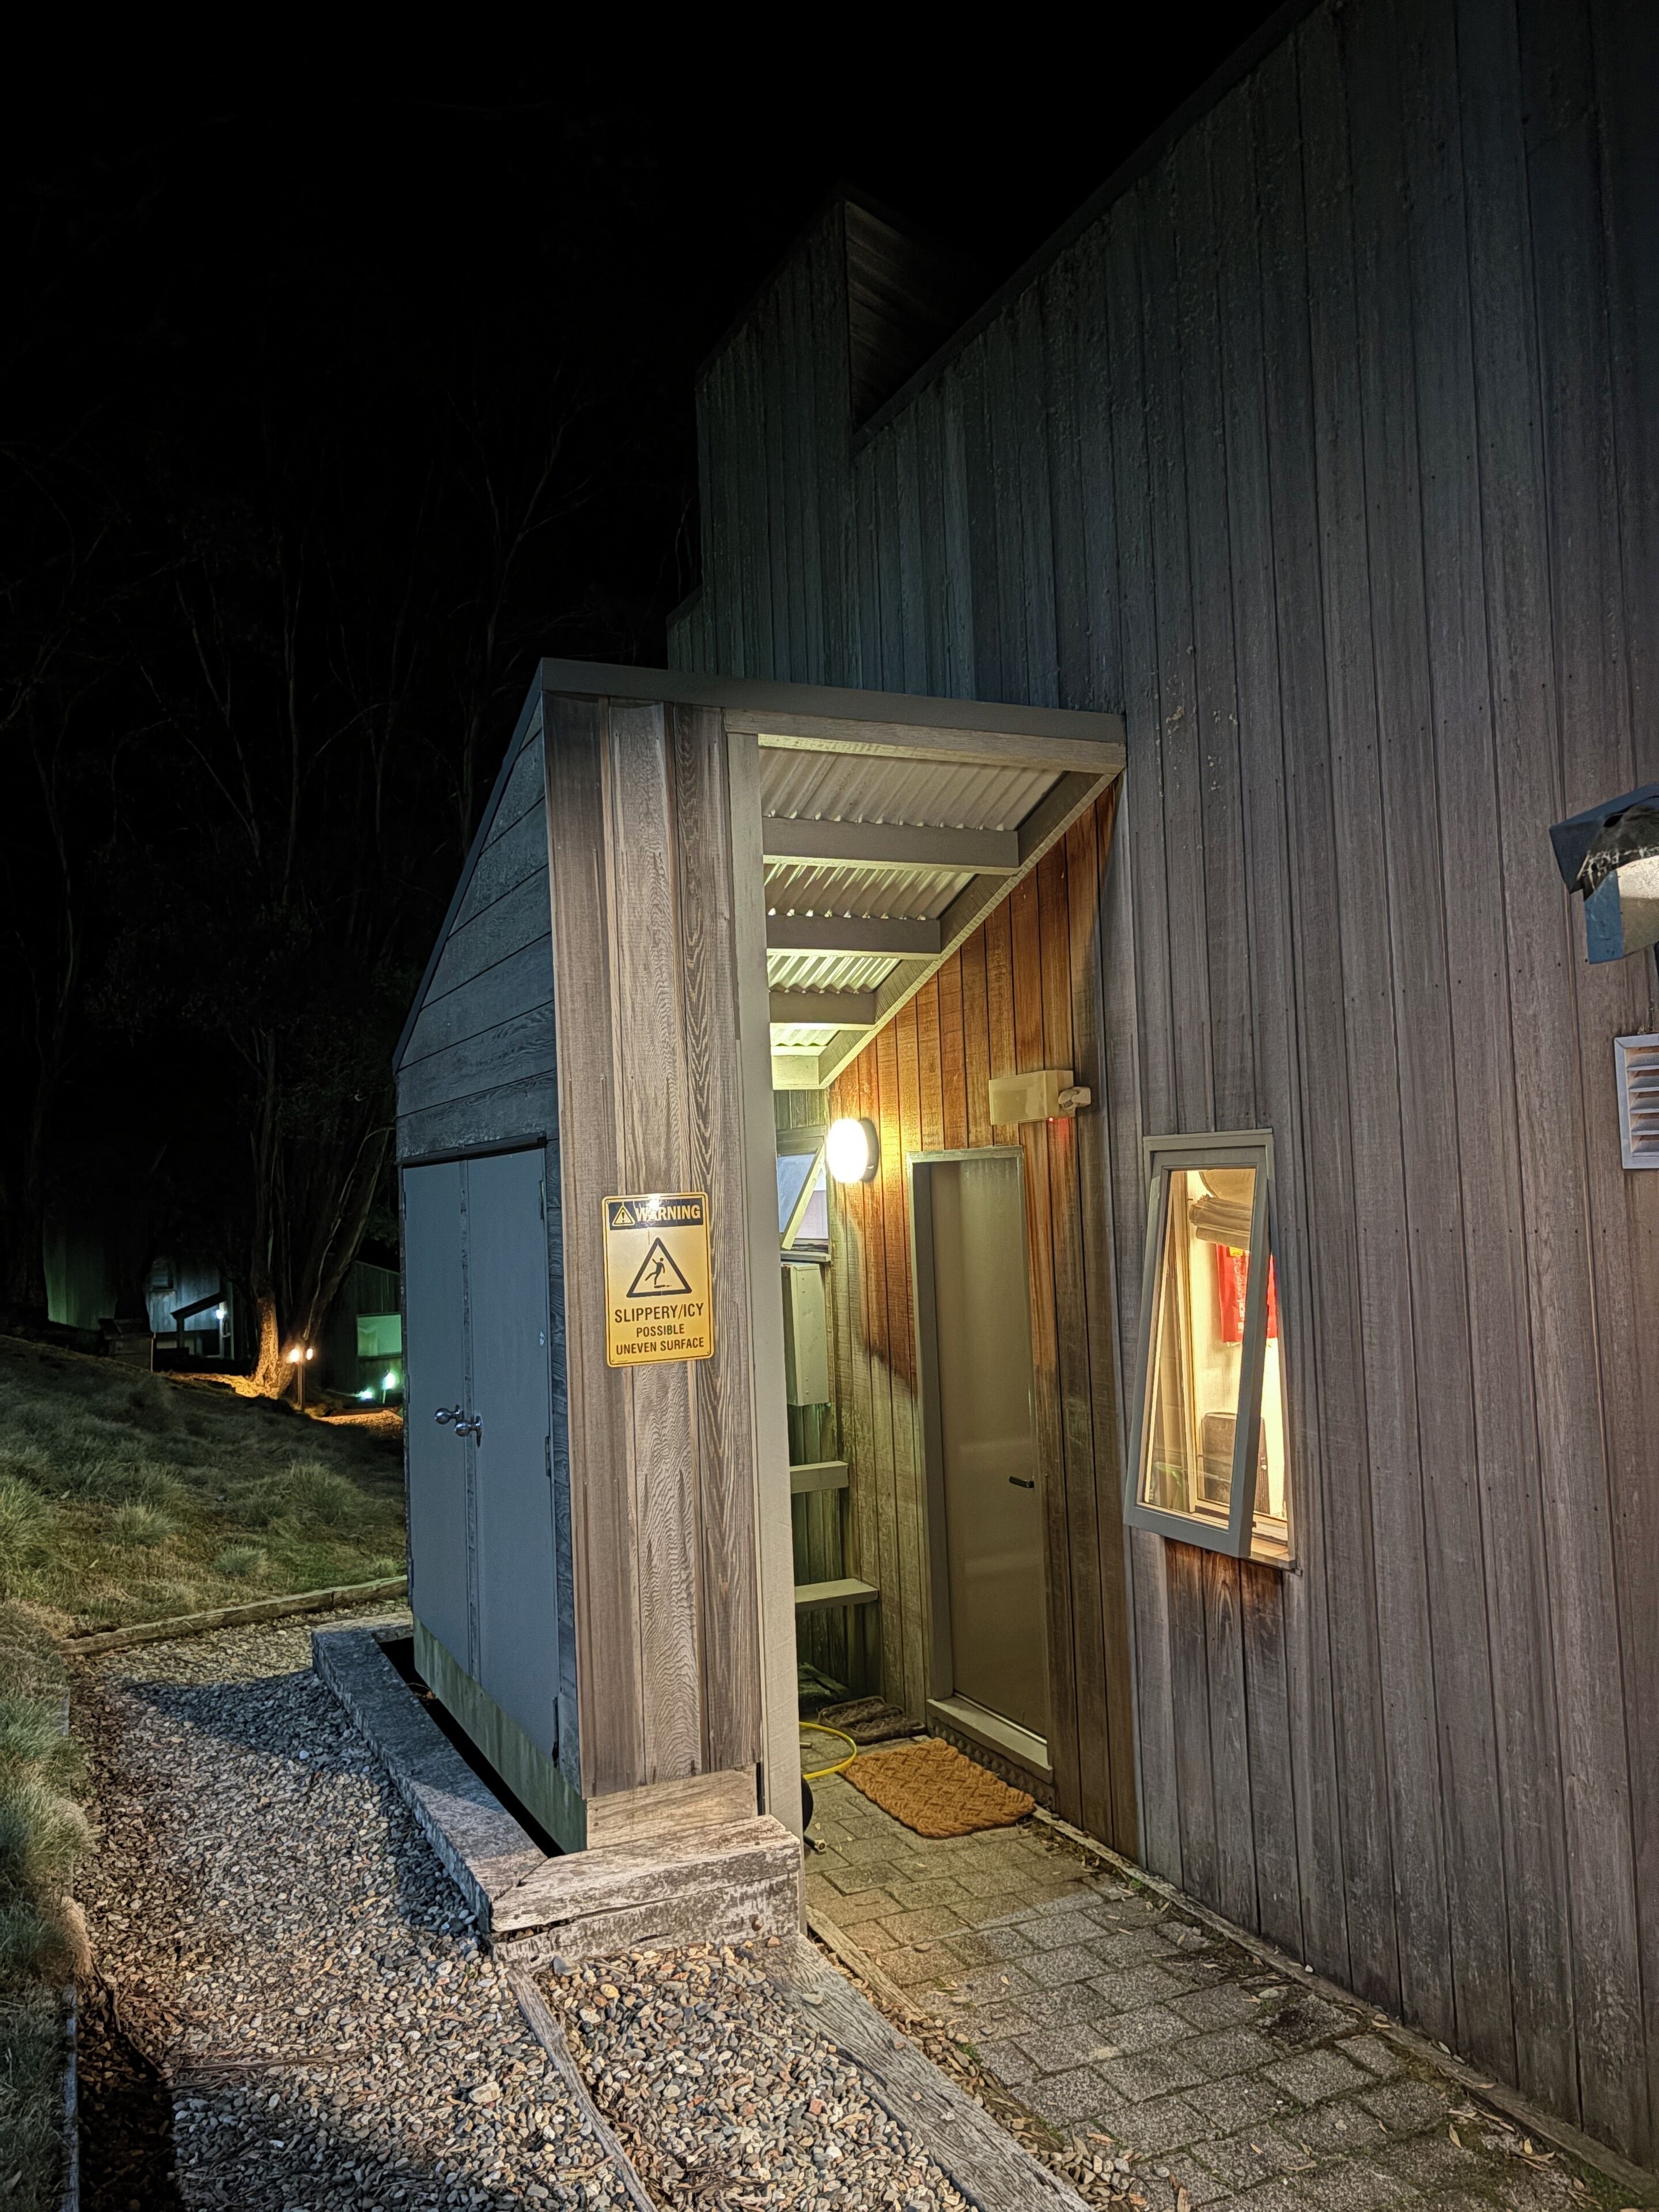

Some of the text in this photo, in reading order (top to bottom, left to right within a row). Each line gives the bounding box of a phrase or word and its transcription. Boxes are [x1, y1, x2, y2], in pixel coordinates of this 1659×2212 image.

[635, 1204, 701, 1222] WARNING
[615, 1302, 703, 1323] SLIPPERY/ICY
[637, 1324, 685, 1338] POSSIBLE
[616, 1337, 704, 1355] UNEVEN SURFACE
